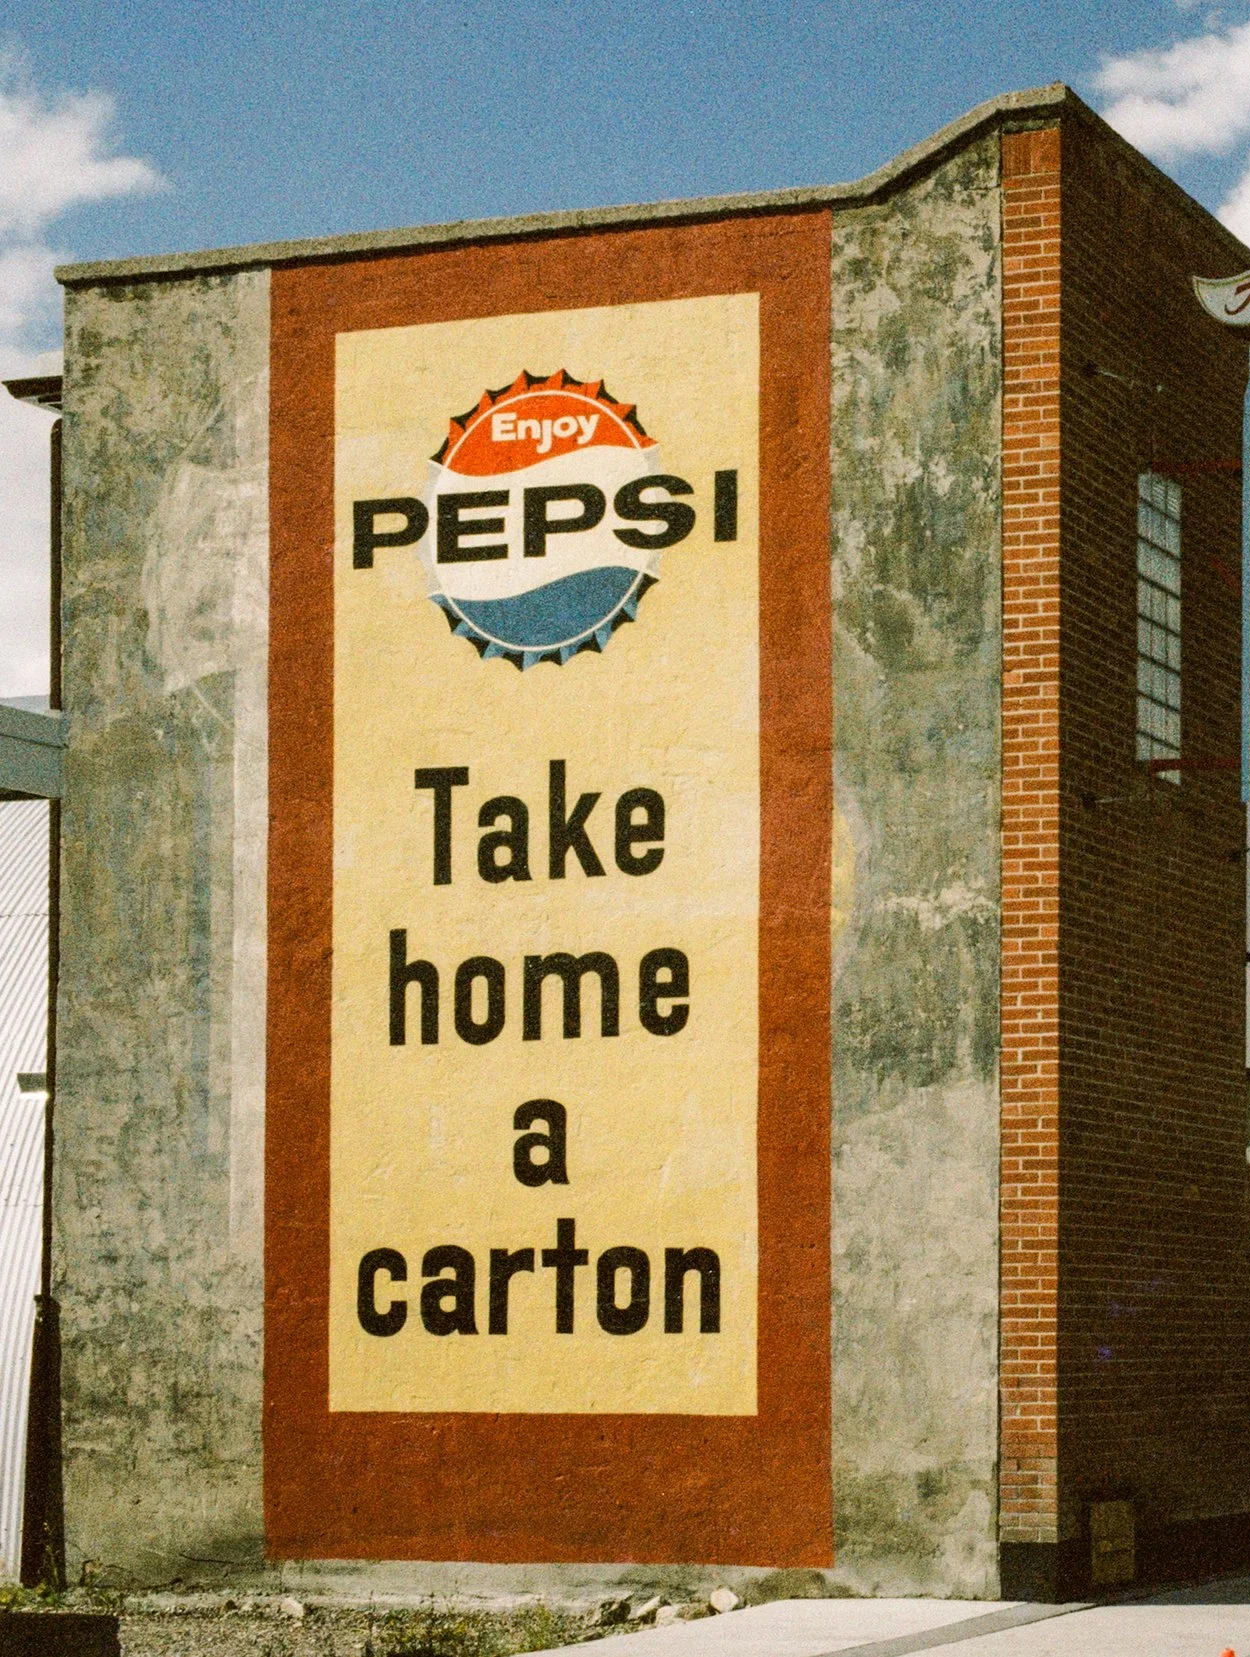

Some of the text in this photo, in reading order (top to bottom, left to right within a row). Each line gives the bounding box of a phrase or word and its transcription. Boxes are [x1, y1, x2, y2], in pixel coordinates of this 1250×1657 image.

[492, 412, 598, 452] Enjoy
[353, 469, 737, 569] PEPSI
[414, 759, 666, 886] Take
[389, 929, 690, 1046] home
[513, 1099, 570, 1187] a
[357, 1218, 721, 1337] carton
